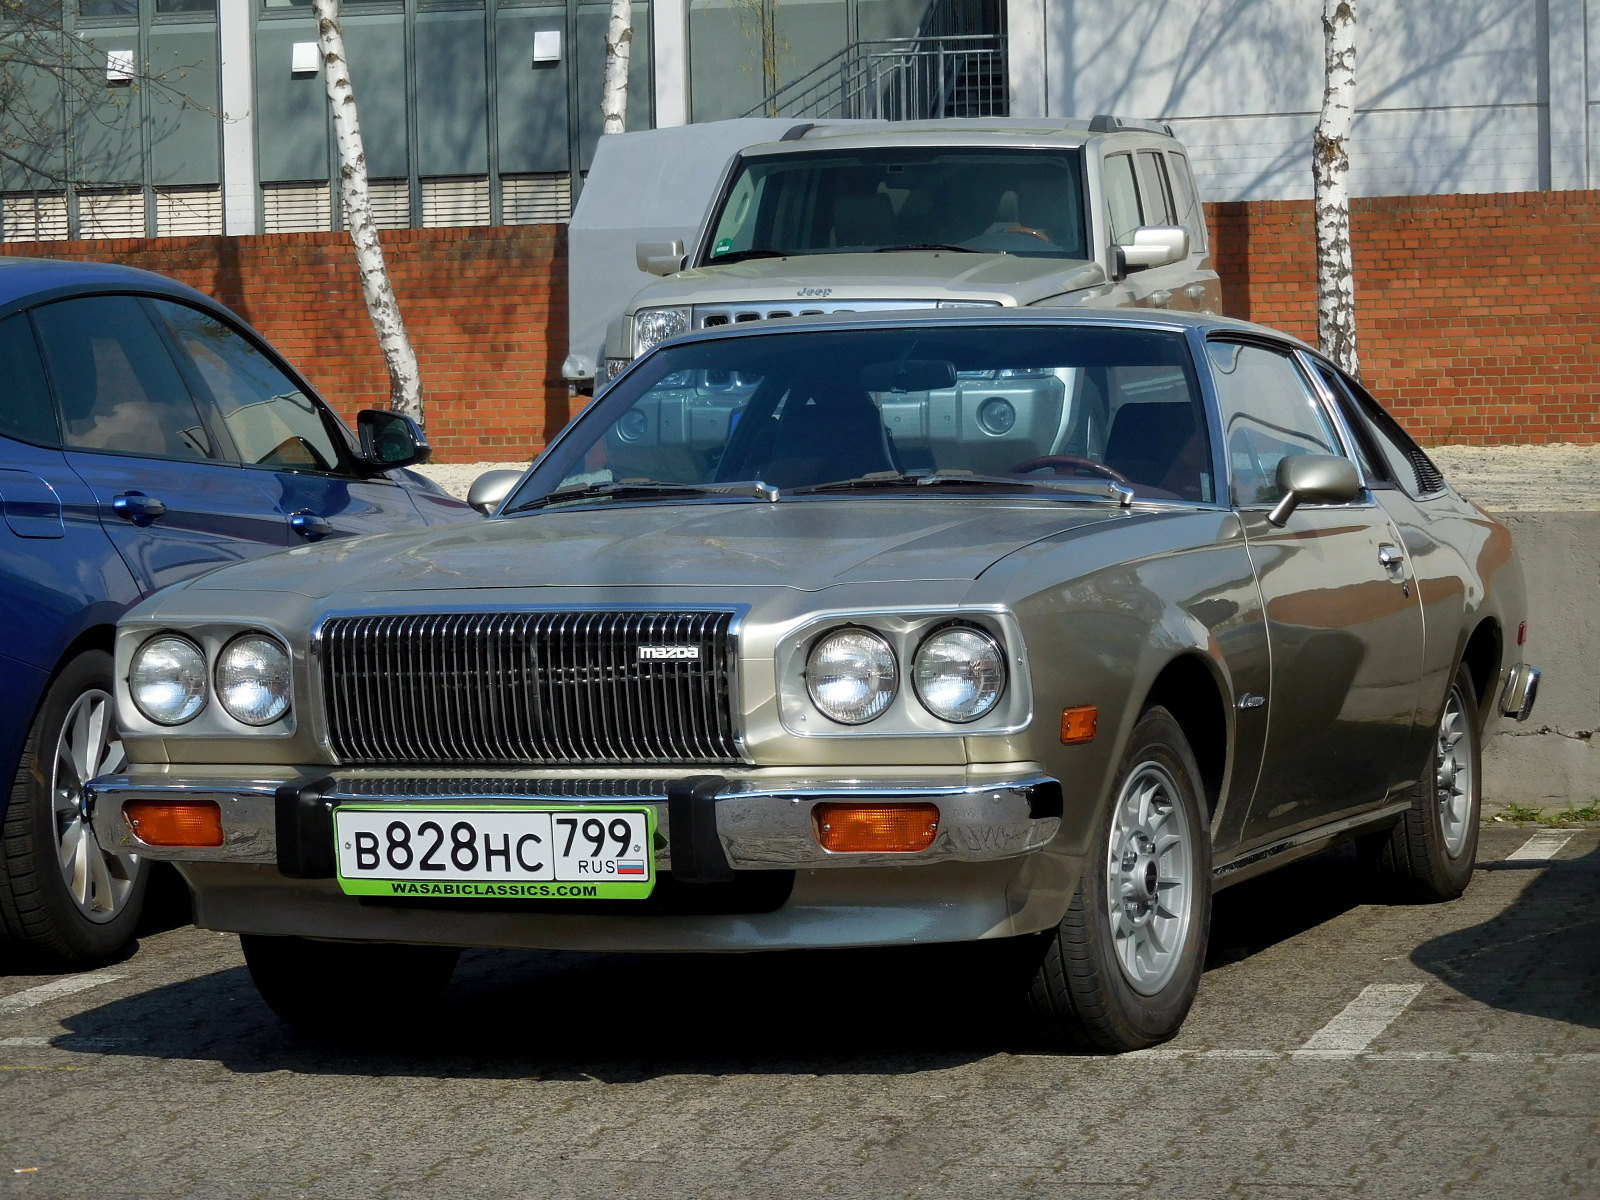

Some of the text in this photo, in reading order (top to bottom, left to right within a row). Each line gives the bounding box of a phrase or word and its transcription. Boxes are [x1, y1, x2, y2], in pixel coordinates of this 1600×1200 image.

[796, 287, 832, 298] Jeep
[639, 647, 699, 659] mazda
[354, 818, 632, 873] B828HC 799
[578, 859, 615, 875] RUS
[391, 883, 598, 897] WASABICLASSICS.COM
